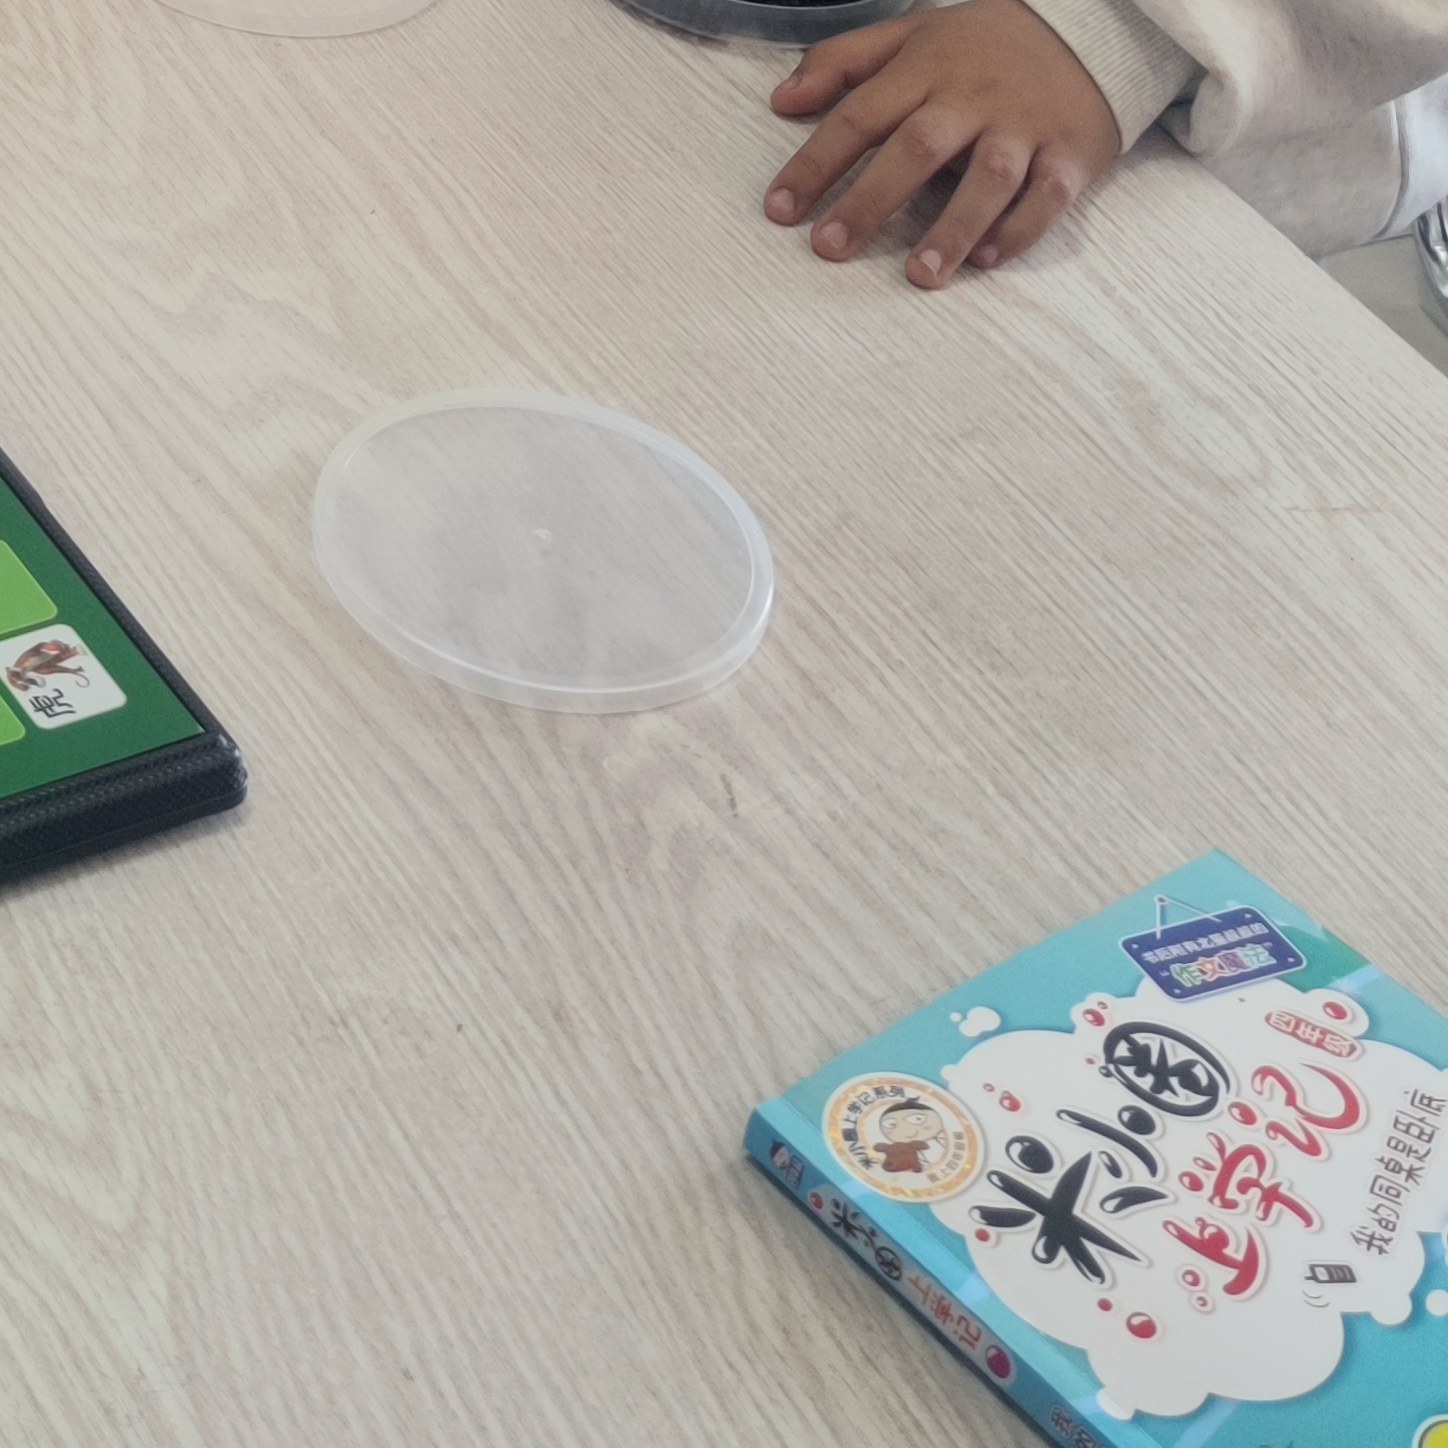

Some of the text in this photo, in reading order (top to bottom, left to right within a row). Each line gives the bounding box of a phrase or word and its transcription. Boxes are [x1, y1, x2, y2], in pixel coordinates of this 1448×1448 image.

[27, 687, 76, 719] 虎
[968, 1021, 1232, 1285] 米小圈
[1162, 1062, 1362, 1297] 上学记
[1349, 1088, 1448, 1256] 我的同桌是卧底
